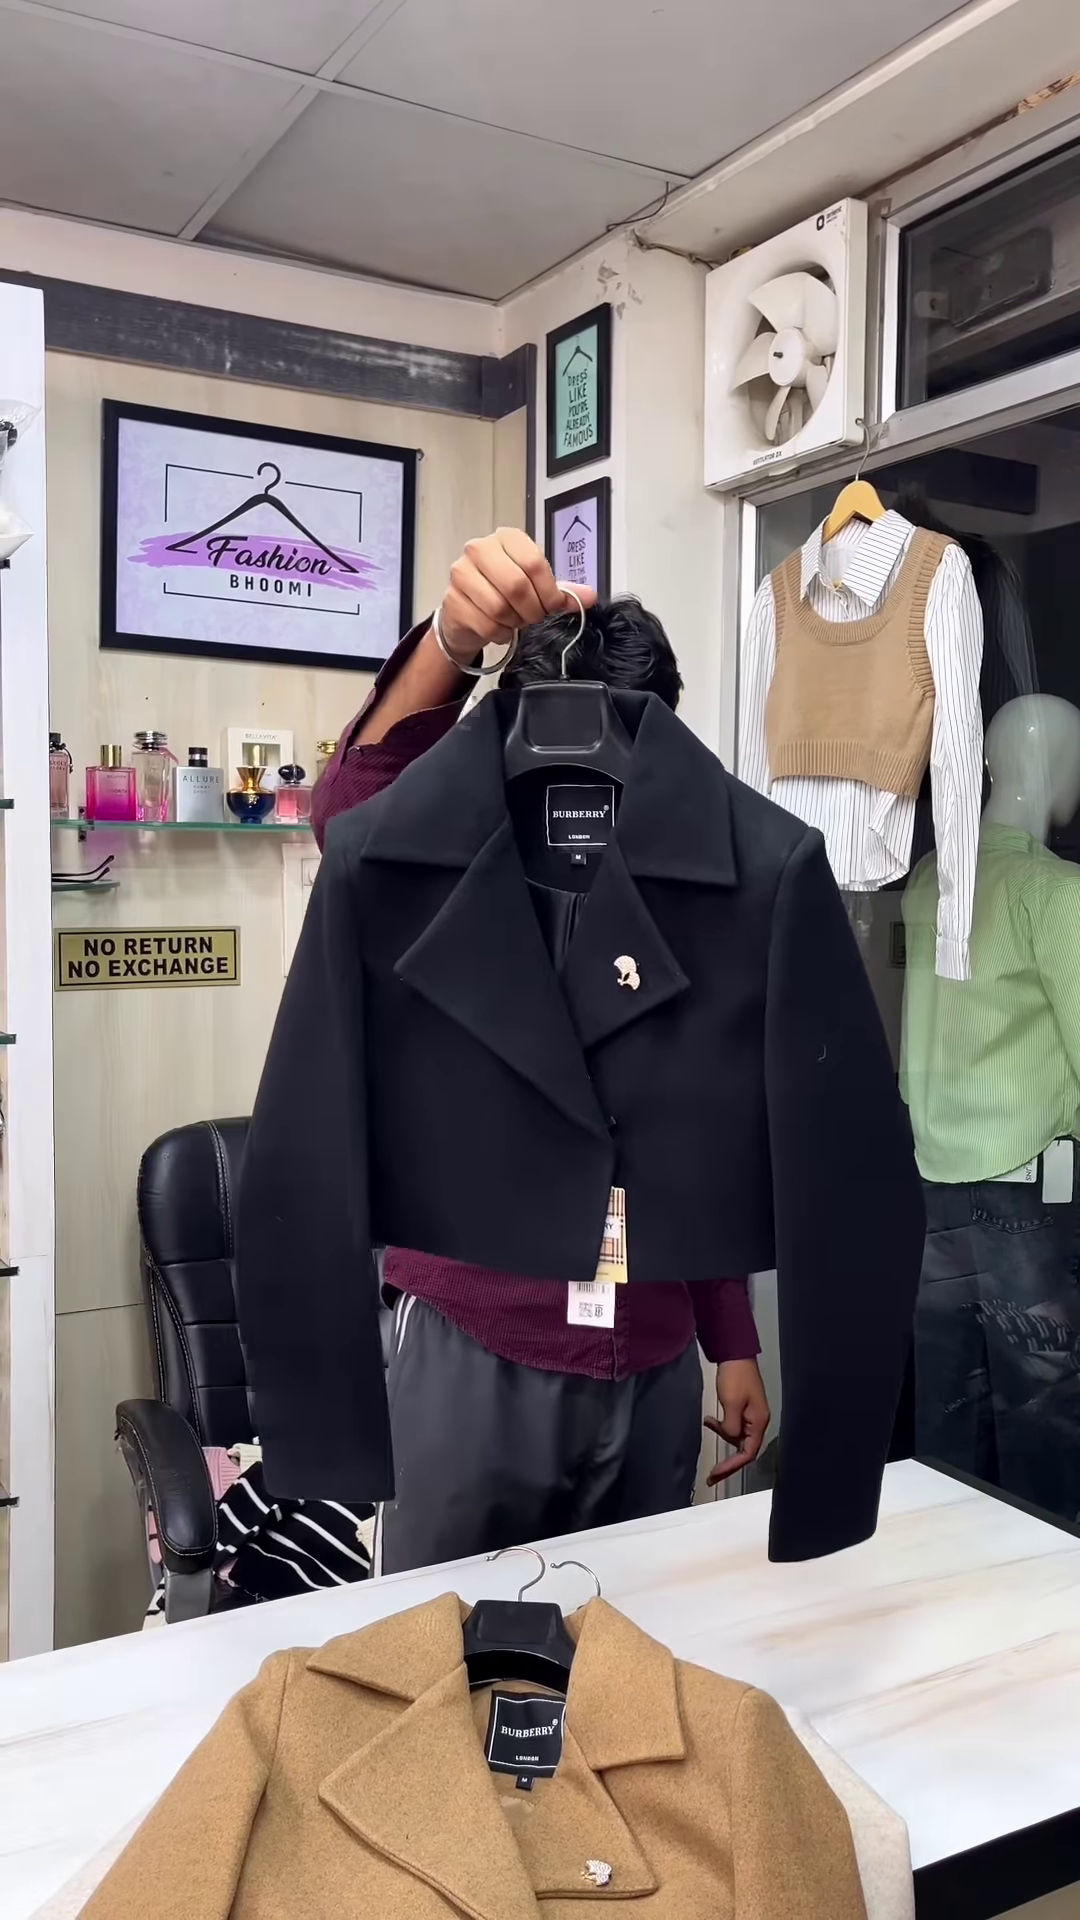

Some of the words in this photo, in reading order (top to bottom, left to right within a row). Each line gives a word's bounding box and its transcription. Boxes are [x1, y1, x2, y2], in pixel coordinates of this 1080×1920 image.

[568, 368, 587, 387] DRESS
[569, 382, 587, 403] LIKE
[566, 411, 590, 430] ALREADY
[564, 424, 593, 447] FAMOUS
[567, 537, 586, 553] DRESS
[206, 536, 331, 576] Fashion
[569, 552, 585, 567] LIKE
[230, 574, 312, 597] BHOOMI
[182, 775, 220, 784] ALLURE
[552, 810, 607, 818] BURBERRY
[84, 938, 116, 957] NO
[124, 936, 213, 956] RETURN
[68, 960, 100, 978] NO
[108, 957, 229, 978] EXCHANGE
[501, 1725, 555, 1738] BURBERRY
